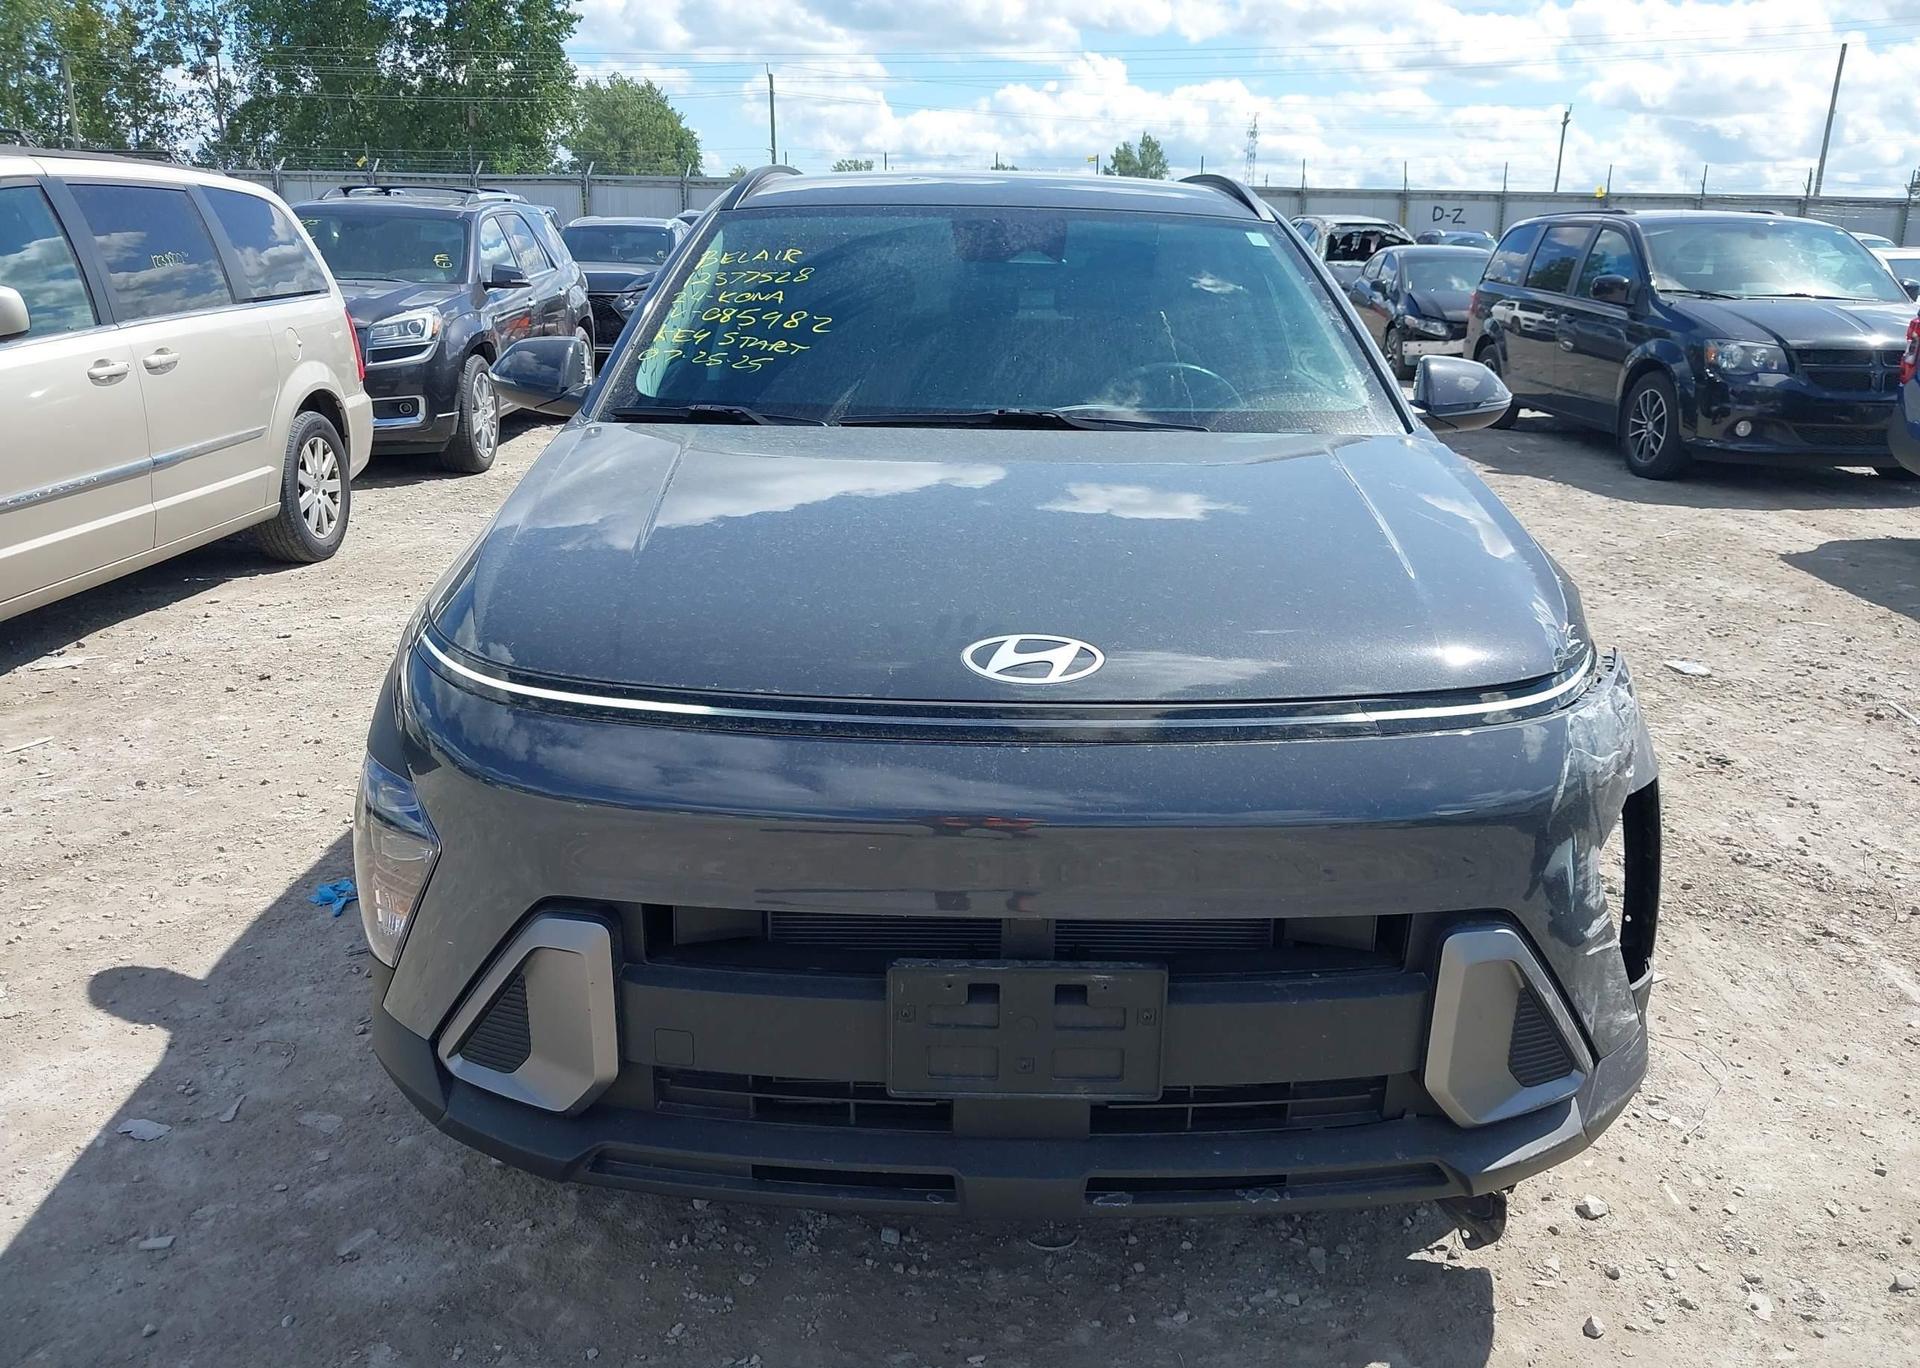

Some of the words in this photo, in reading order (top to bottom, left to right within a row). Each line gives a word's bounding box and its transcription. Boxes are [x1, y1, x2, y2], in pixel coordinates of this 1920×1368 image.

[1432, 206, 1466, 224] D-Z
[695, 249, 803, 270] BELAIR
[653, 323, 711, 345] KEY
[718, 331, 811, 355] START
